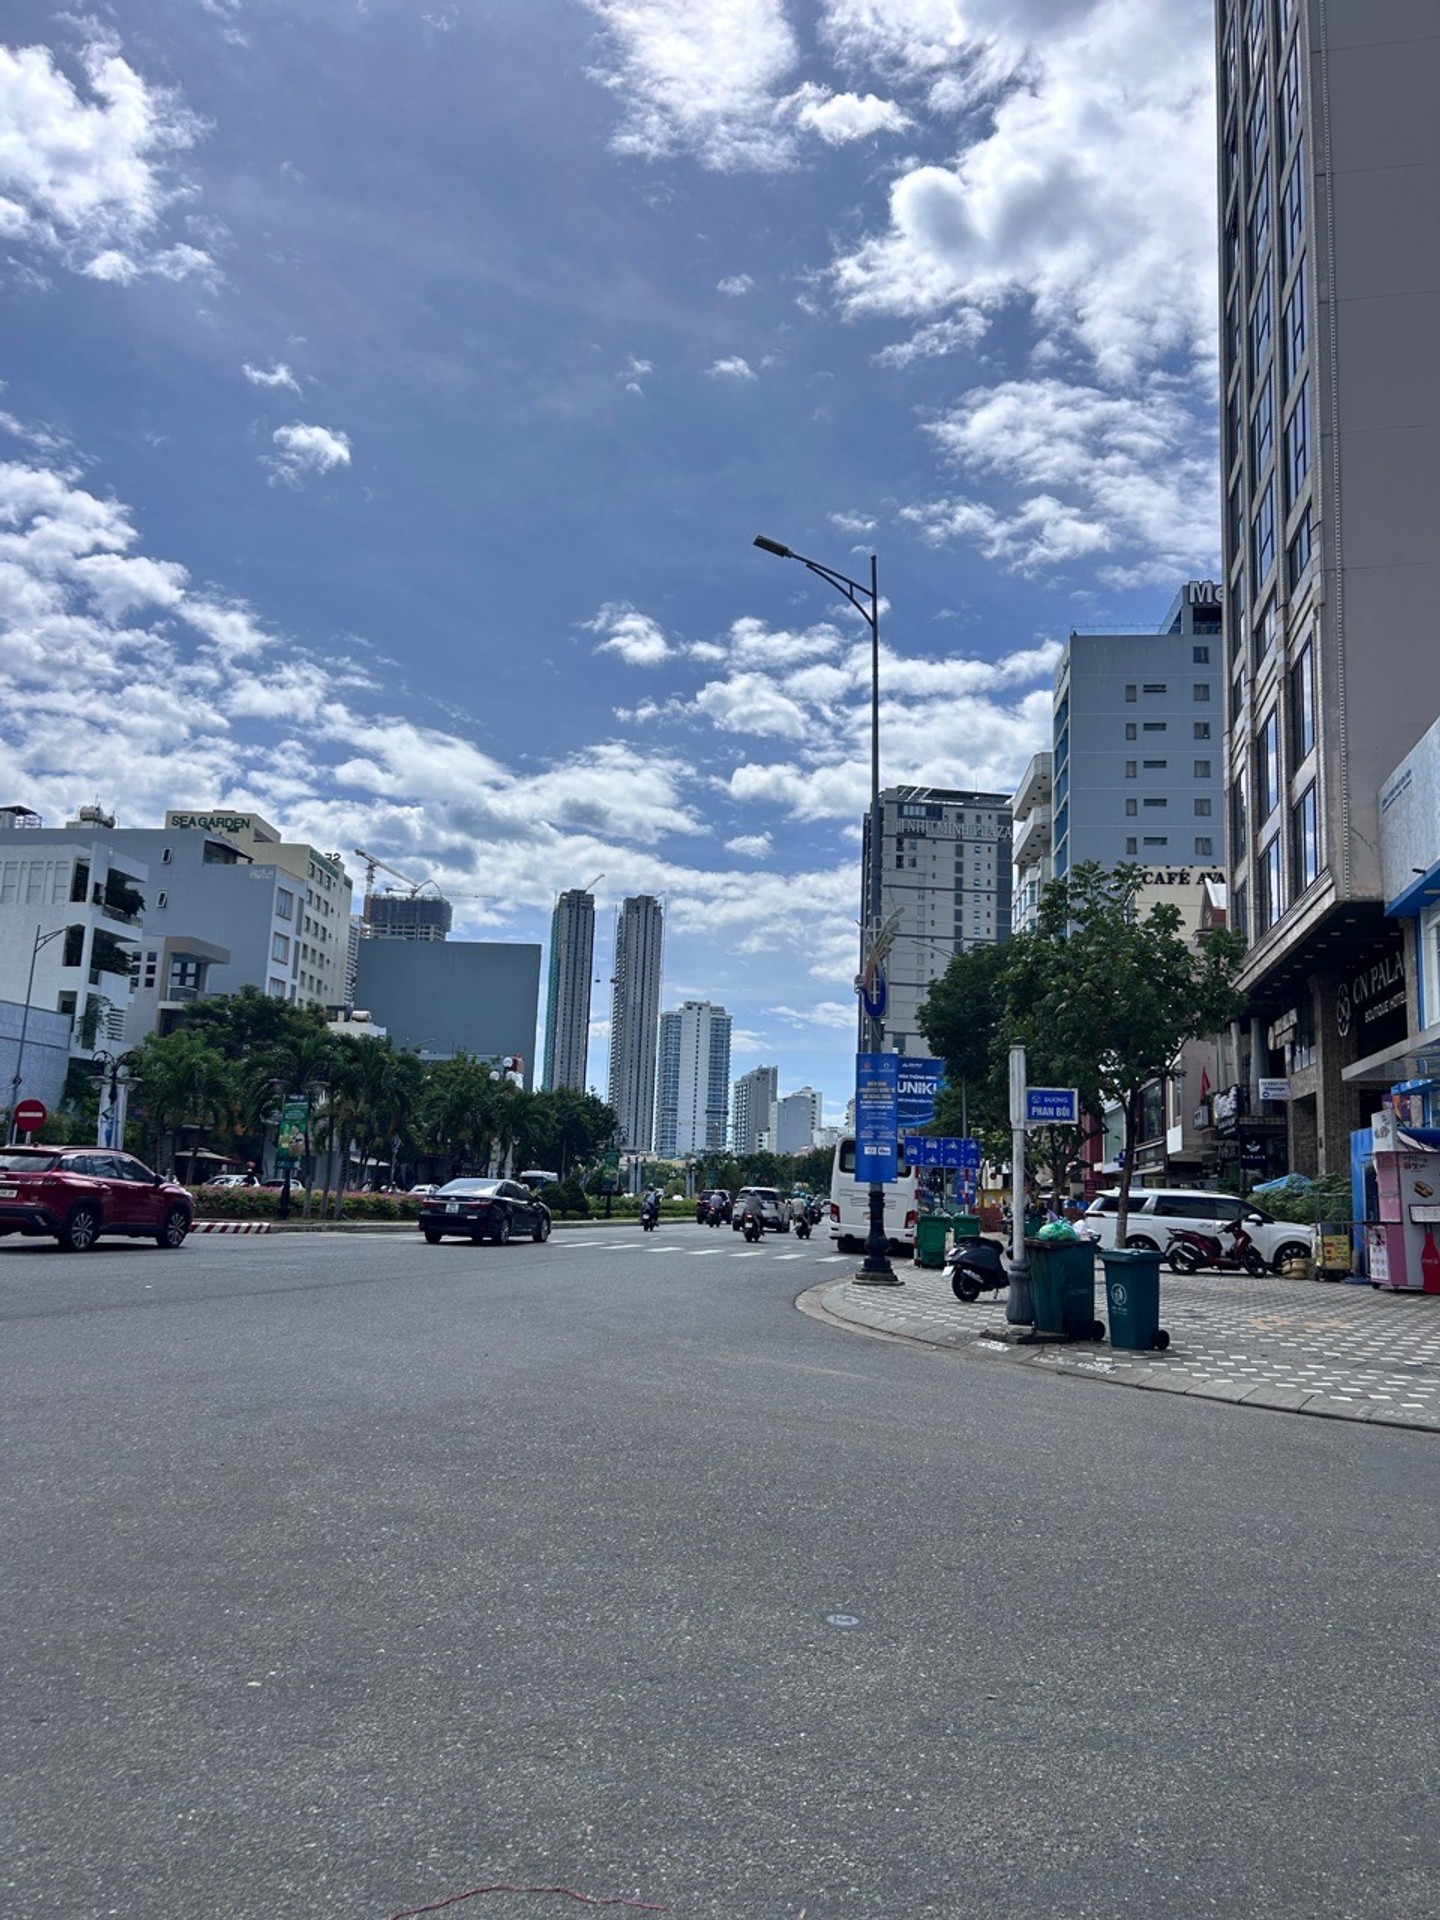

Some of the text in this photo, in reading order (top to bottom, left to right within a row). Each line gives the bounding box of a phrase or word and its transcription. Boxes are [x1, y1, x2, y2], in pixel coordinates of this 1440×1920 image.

[172, 816, 250, 829] SEA GARDEN
[1142, 868, 1190, 884] CAFÉ
[1031, 1106, 1054, 1116] PHAN
